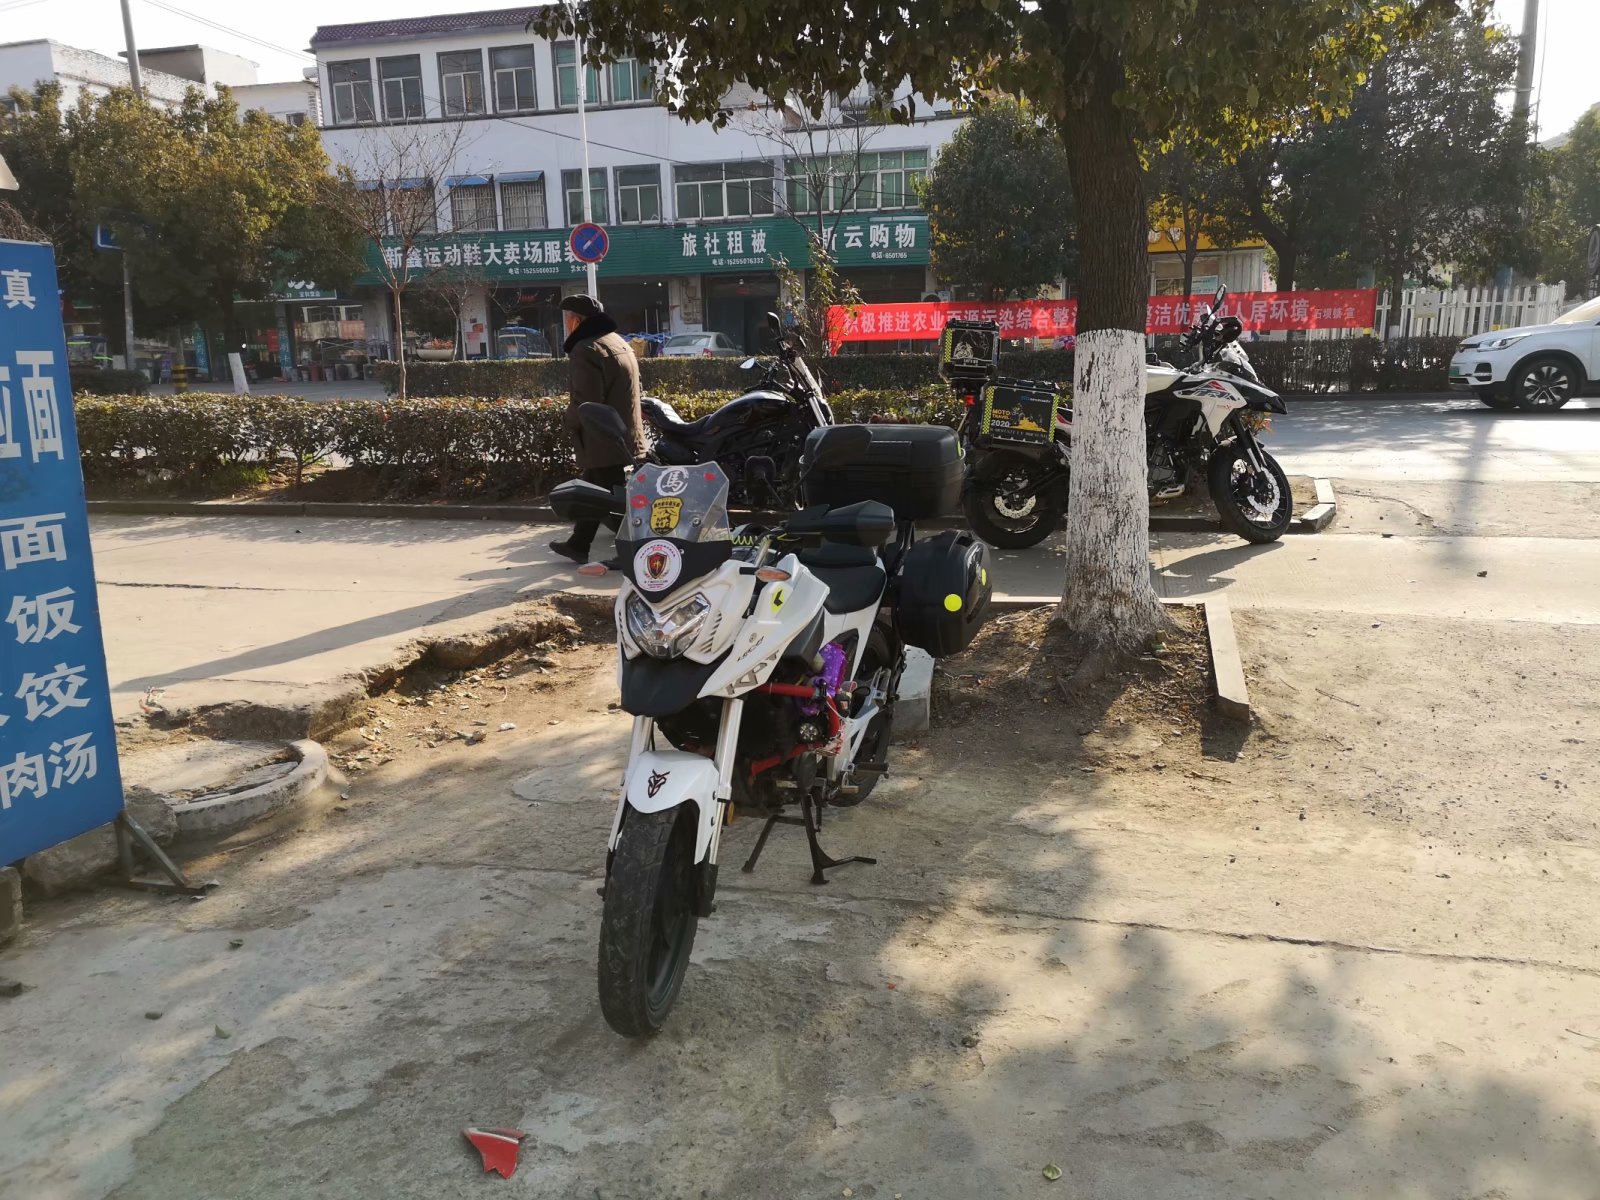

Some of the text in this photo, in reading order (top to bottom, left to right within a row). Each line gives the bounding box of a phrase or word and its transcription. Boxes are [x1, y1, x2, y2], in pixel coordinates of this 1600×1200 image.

[682, 229, 767, 256] 旅社租被
[1, 269, 36, 310] 真
[991, 420, 1010, 428] 2020
[5, 586, 83, 645] 饭
[0, 662, 91, 722] 饺
[0, 731, 98, 810] 肉汤
